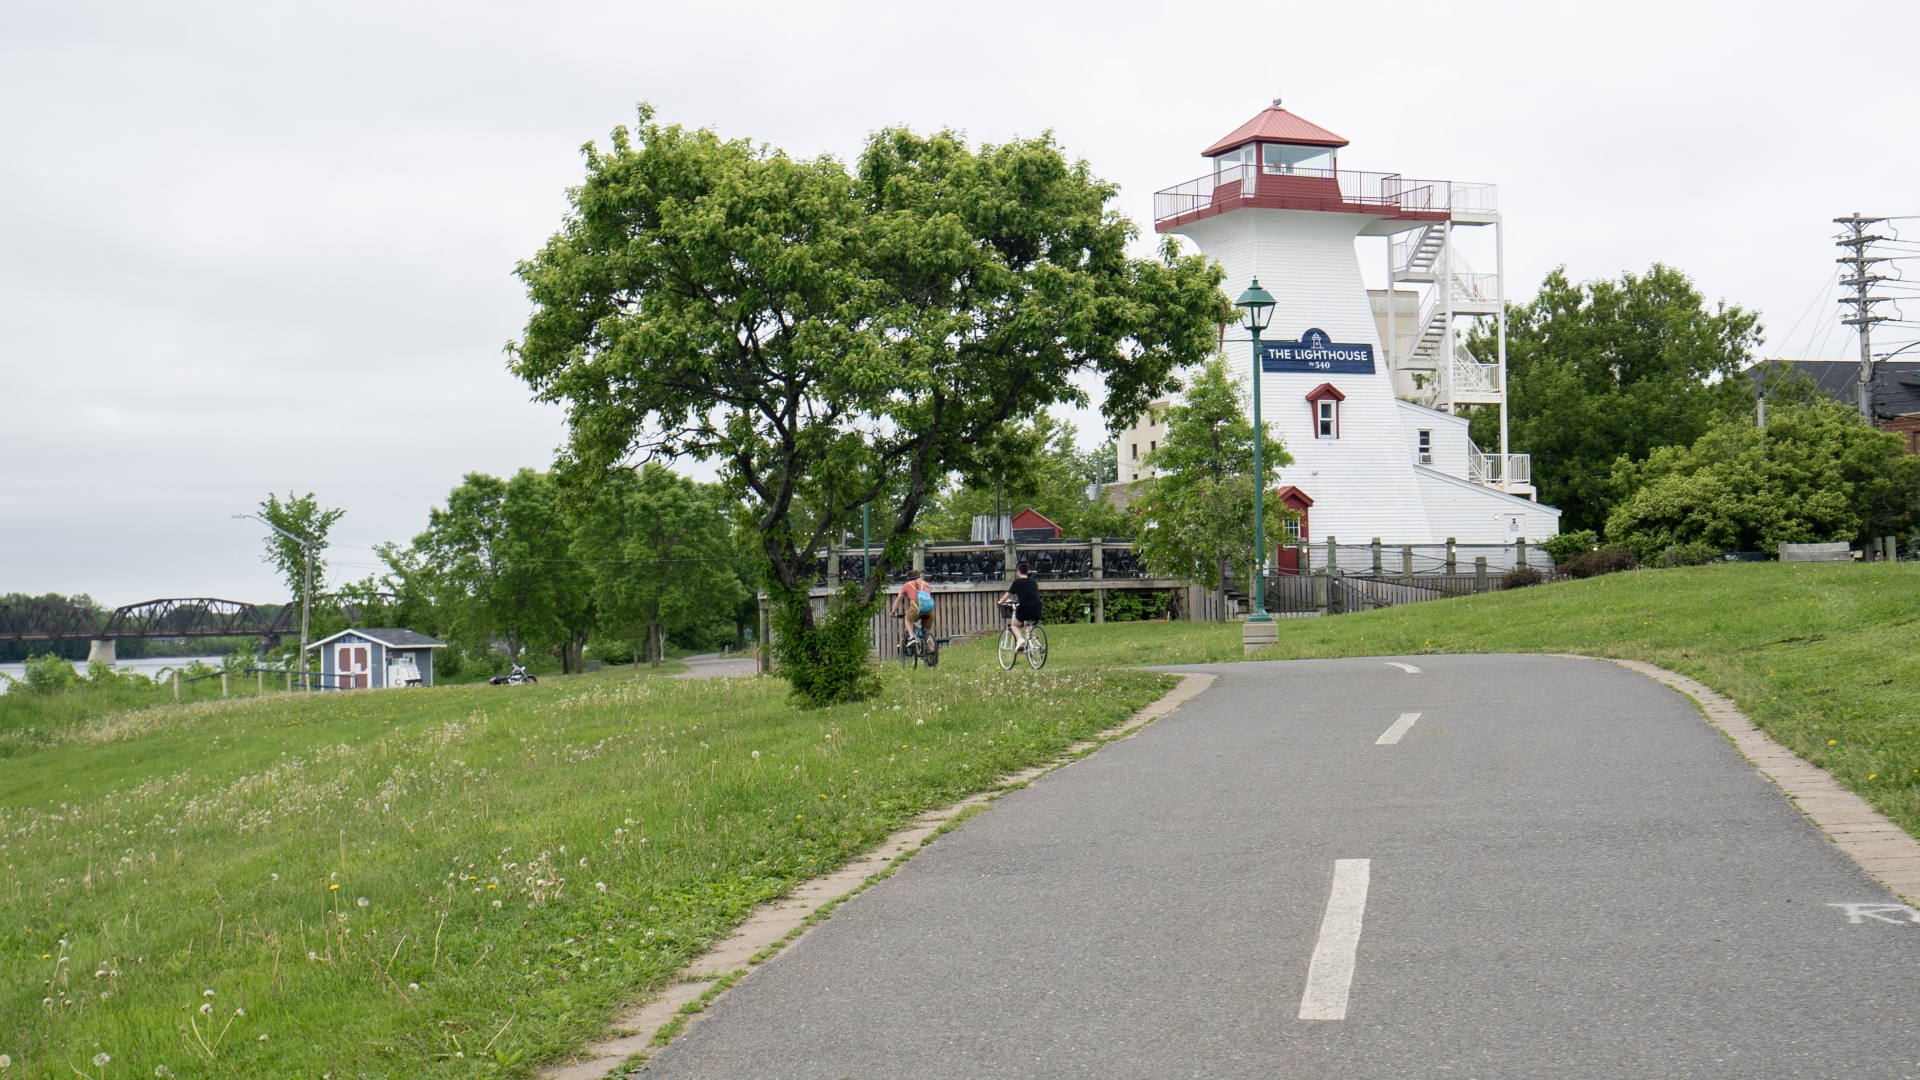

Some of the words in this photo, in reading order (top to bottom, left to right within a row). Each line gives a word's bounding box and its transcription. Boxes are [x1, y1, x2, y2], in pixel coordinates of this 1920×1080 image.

[1268, 349, 1292, 360] THE
[1294, 350, 1368, 361] LIGHTHOUSE
[1315, 361, 1331, 369] 540
